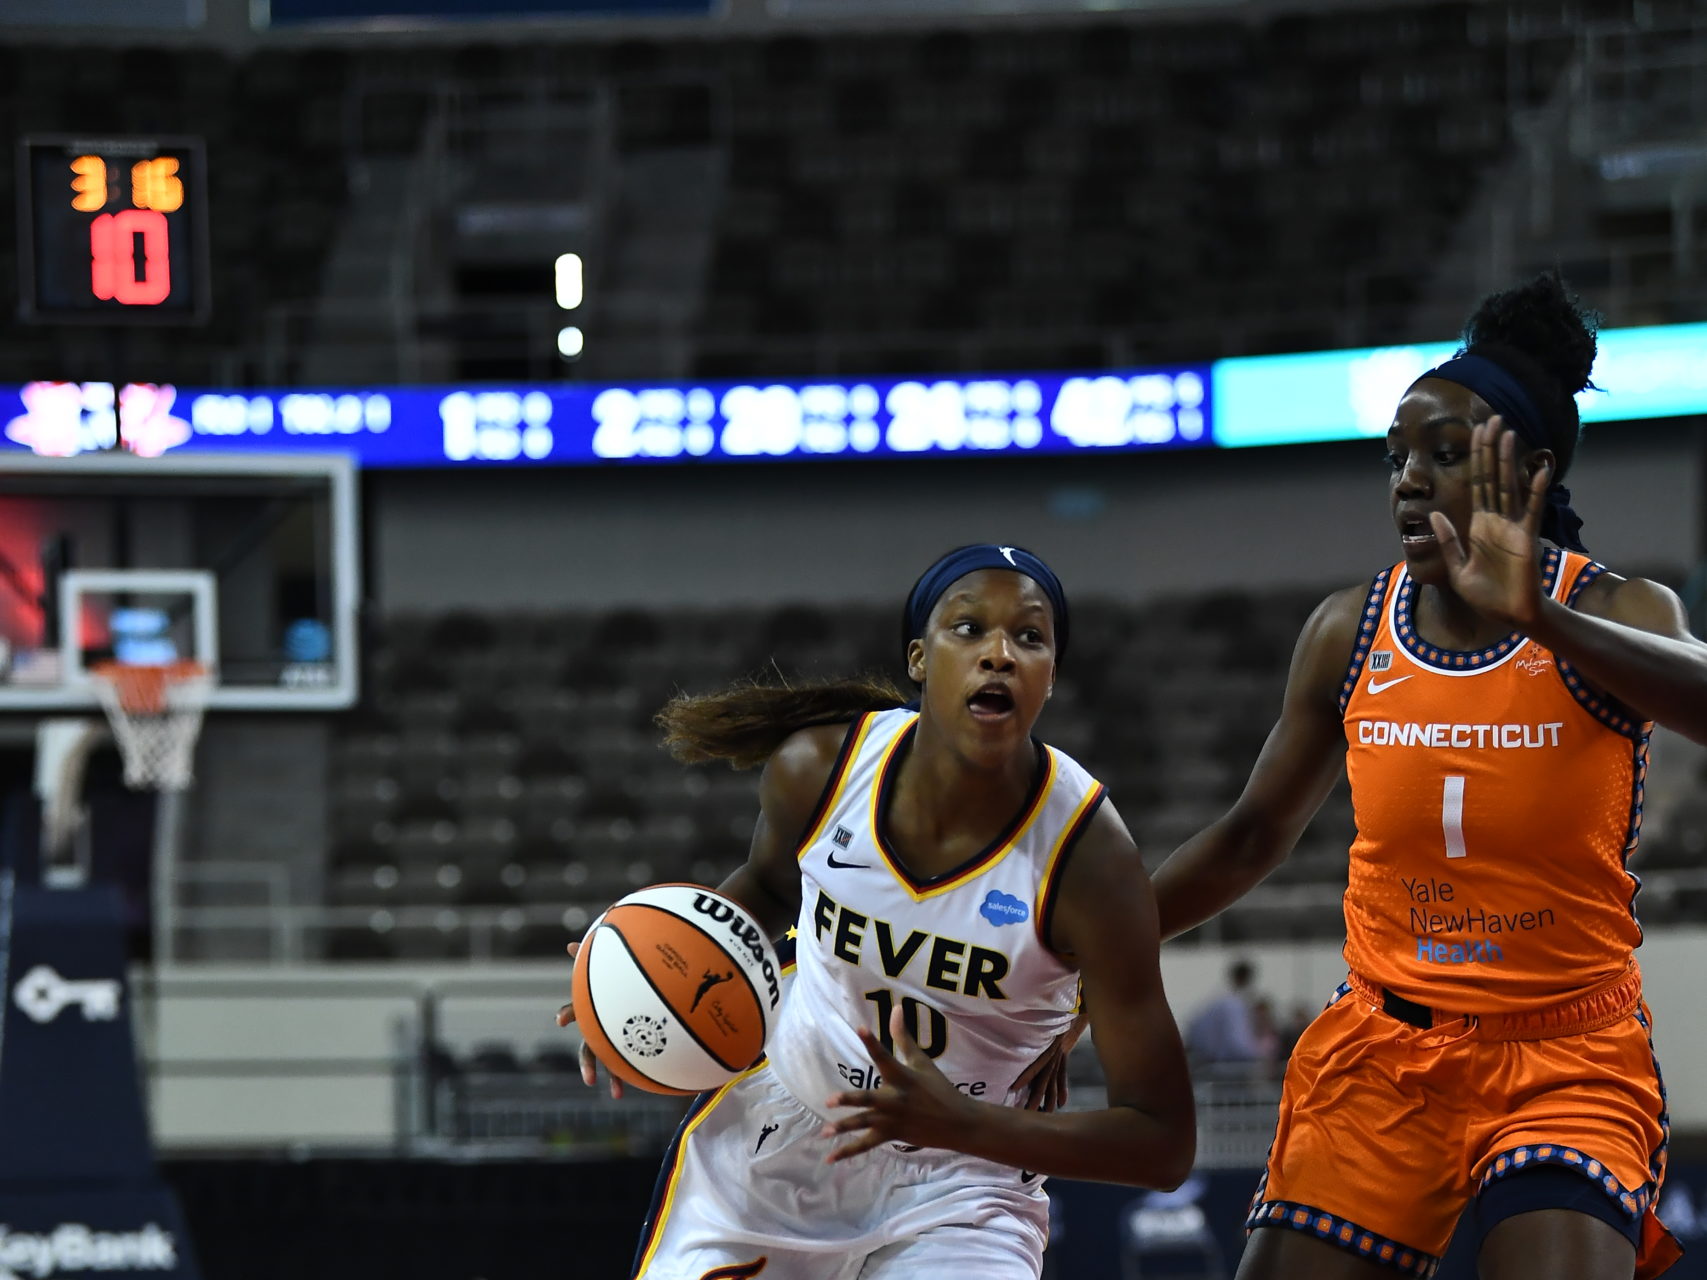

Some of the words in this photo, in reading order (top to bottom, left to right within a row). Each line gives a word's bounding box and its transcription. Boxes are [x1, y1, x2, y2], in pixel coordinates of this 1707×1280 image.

[90, 209, 171, 305] 10
[1358, 720, 1564, 749] CONNECTICUT
[1442, 776, 1467, 859] 1
[988, 902, 1026, 917] salesforce
[1401, 877, 1455, 903] Yale
[814, 889, 1010, 1000] FEVER
[1410, 907, 1555, 934] NewHaven
[693, 892, 780, 1011] Wilson
[1416, 935, 1505, 964] Health
[864, 988, 949, 1060] 10
[0, 1222, 177, 1278] eyBank
